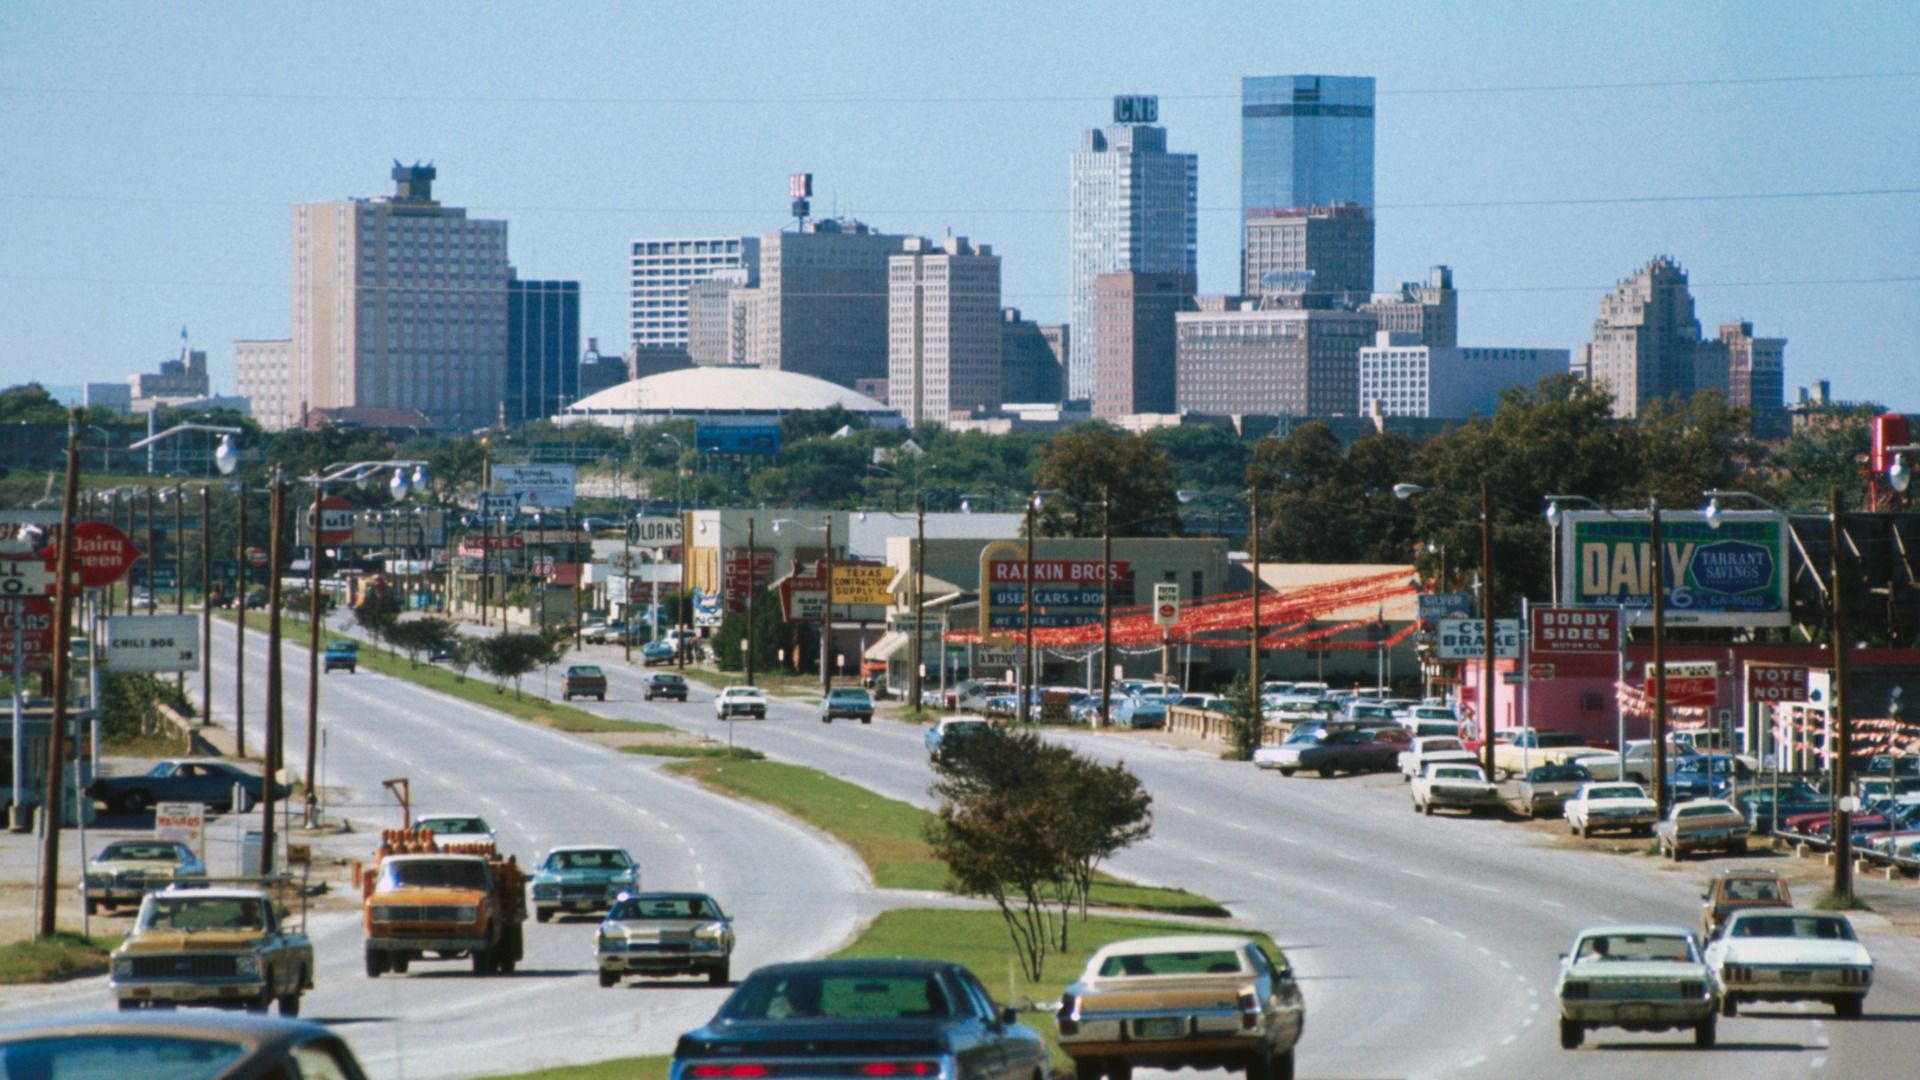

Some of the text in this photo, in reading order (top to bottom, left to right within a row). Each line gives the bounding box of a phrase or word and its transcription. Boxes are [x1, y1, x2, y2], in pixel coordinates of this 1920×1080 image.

[1119, 96, 1158, 120] CNB
[1463, 349, 1537, 361] SHERATON
[641, 523, 682, 540] LOANS
[465, 538, 522, 547] MOTEL
[73, 554, 122, 567] een
[1700, 552, 1765, 565] TARRANT
[846, 569, 882, 577] TEXAS
[996, 563, 1123, 580] RAKIN BROS.
[1582, 543, 1695, 595] DAIY
[1705, 565, 1760, 579] SAVINGS
[725, 551, 736, 612] MOTEL
[835, 587, 874, 595] SUPPLY
[1034, 593, 1070, 604] CARS
[1016, 617, 1057, 626] FIANCE
[1543, 613, 1610, 625] BOBBY
[1543, 628, 1610, 640] SIDES
[112, 639, 145, 648] CHILI
[1754, 669, 1804, 681] TOTE
[1754, 687, 1804, 699] NOTE
